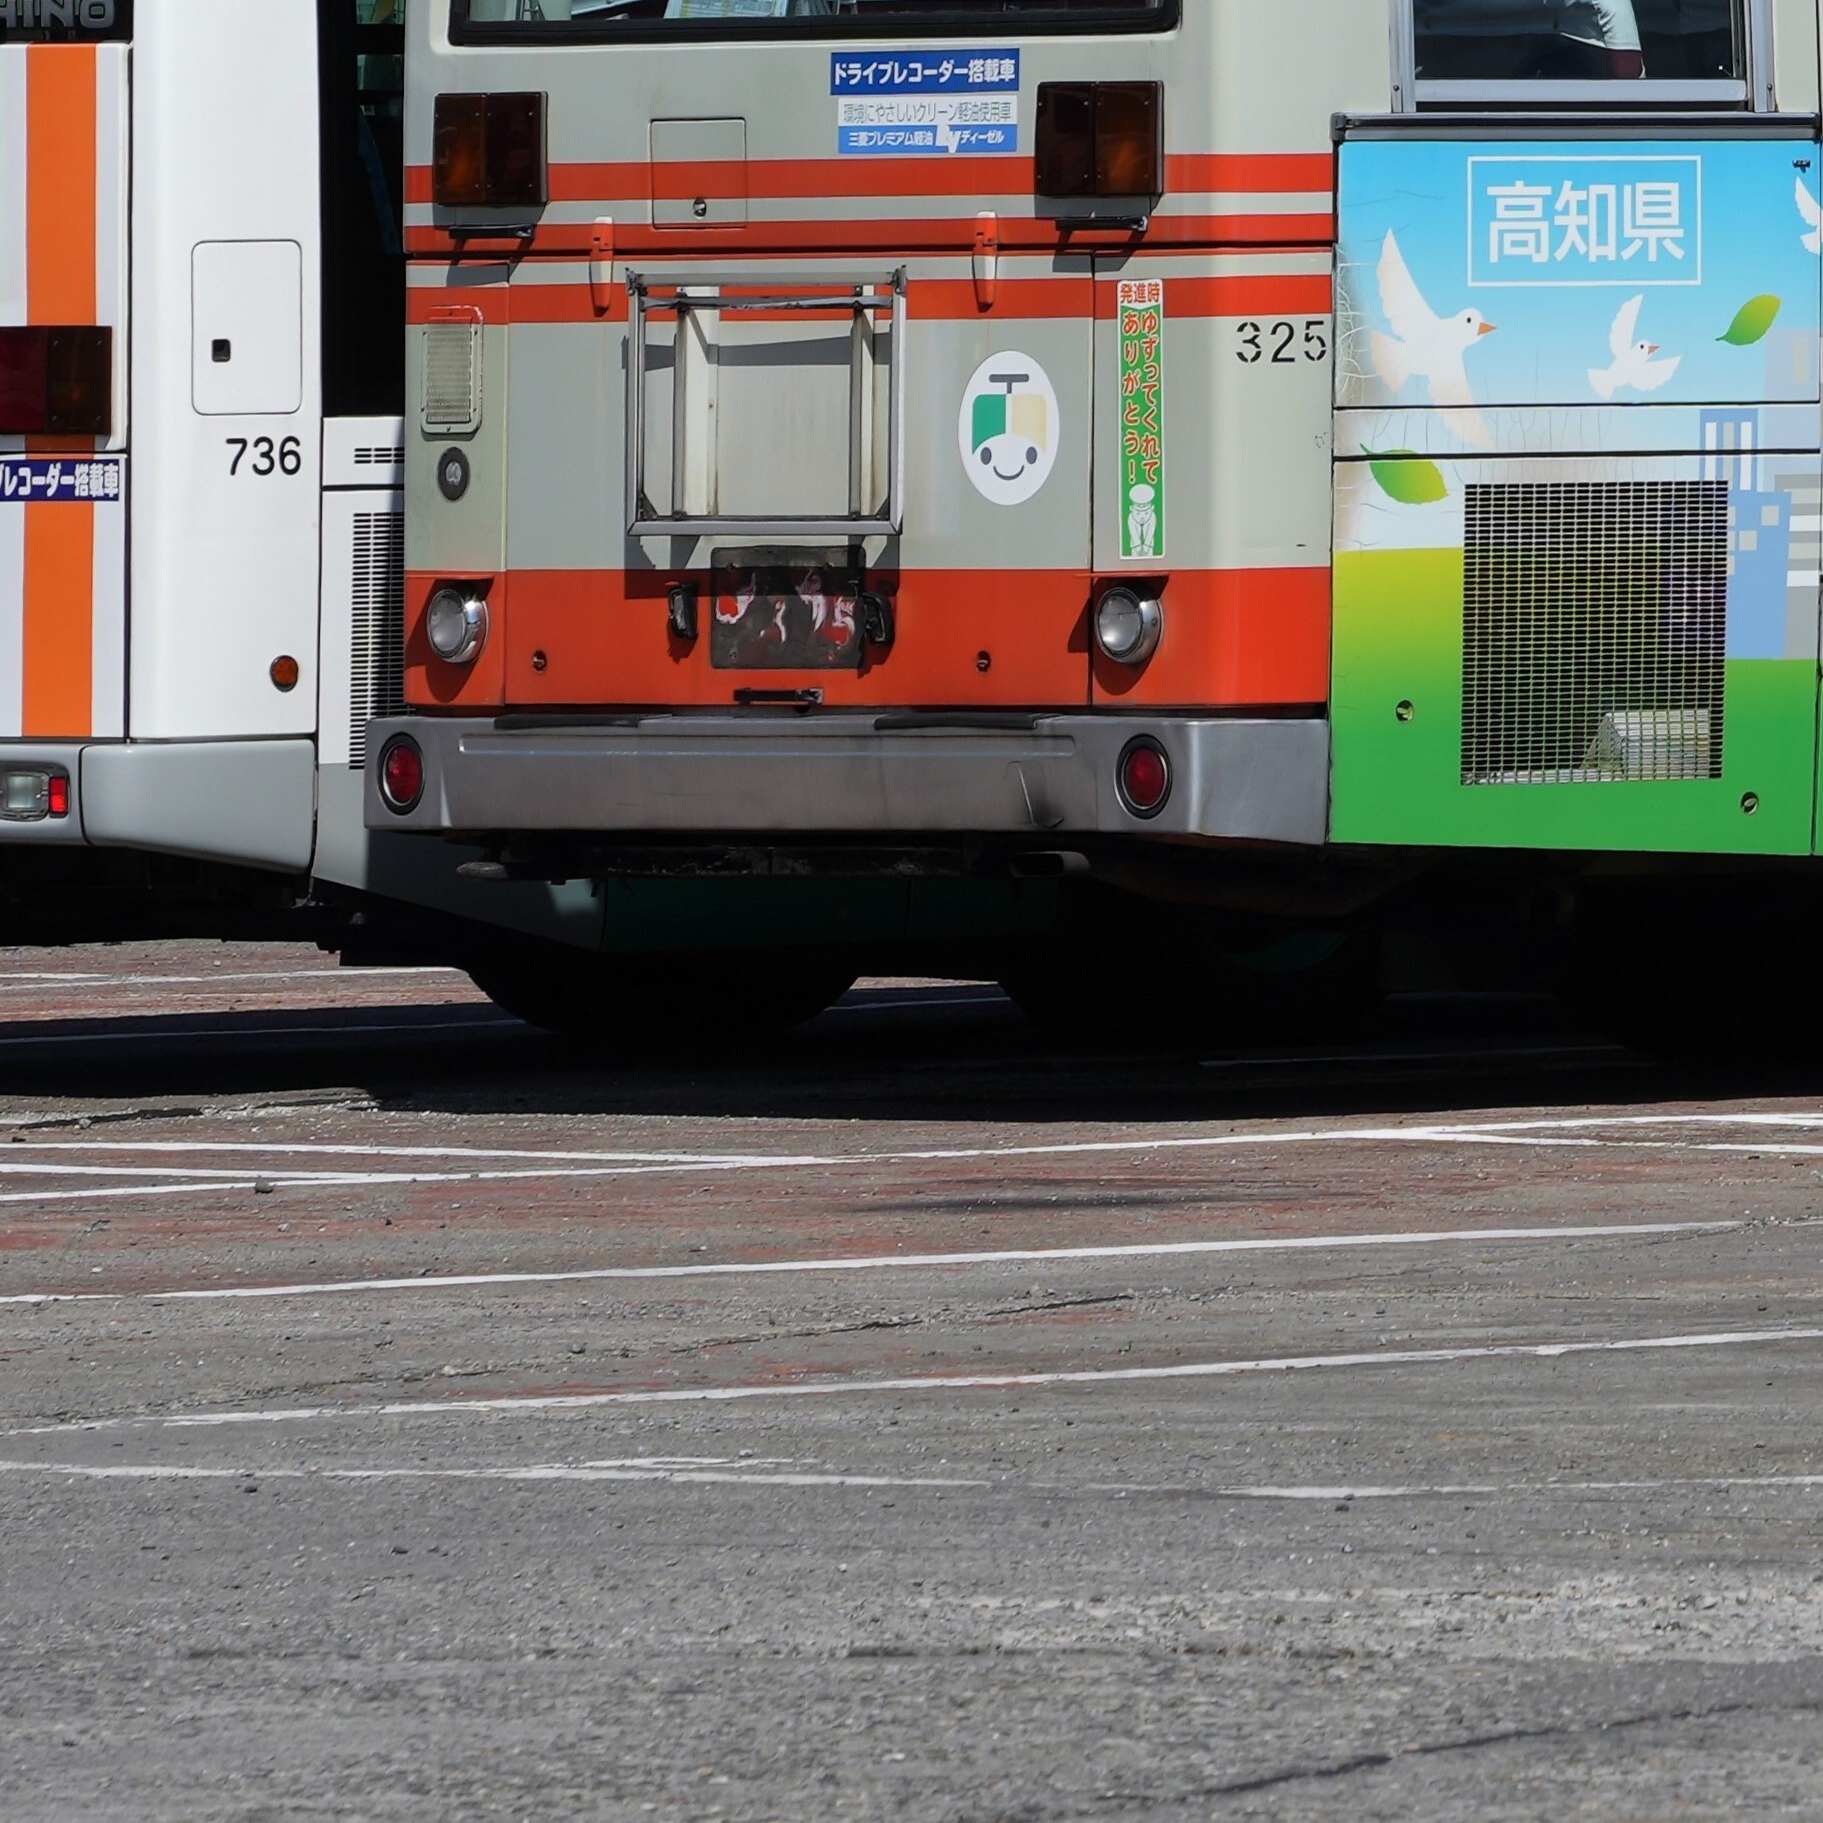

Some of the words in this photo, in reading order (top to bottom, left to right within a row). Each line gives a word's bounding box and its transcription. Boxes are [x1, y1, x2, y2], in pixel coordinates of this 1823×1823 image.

[834, 57, 1016, 85] ドライブレコーダー搭載車
[843, 101, 1012, 123] 環境にやさしいクリーン軽油使用車
[1486, 180, 1685, 264] 高知県
[1120, 283, 1160, 304] 発進時
[1235, 320, 1327, 364] 325
[1123, 310, 1141, 484] ありがとう！
[1141, 310, 1160, 483] ゆずってくれて
[225, 437, 302, 477] 736
[0, 461, 119, 498] レコーダー搭載車
